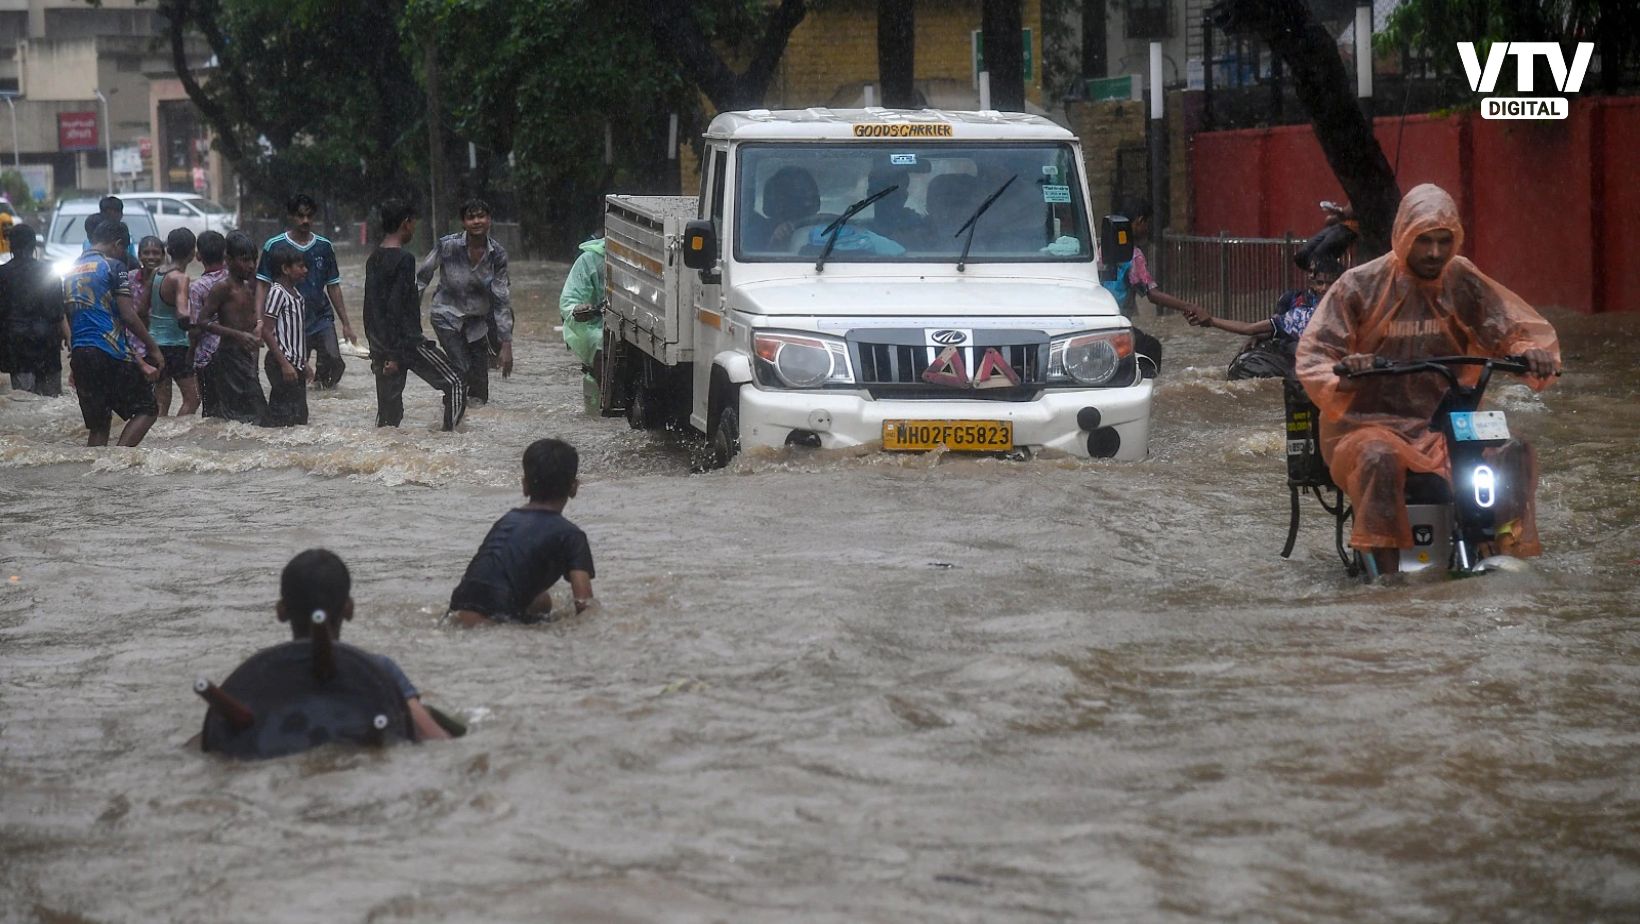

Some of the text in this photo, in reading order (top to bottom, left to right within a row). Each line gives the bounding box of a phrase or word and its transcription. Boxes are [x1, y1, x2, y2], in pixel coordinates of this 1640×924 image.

[854, 124, 951, 137] GOODS CARRIER
[897, 424, 1009, 445] MH02FG5823
